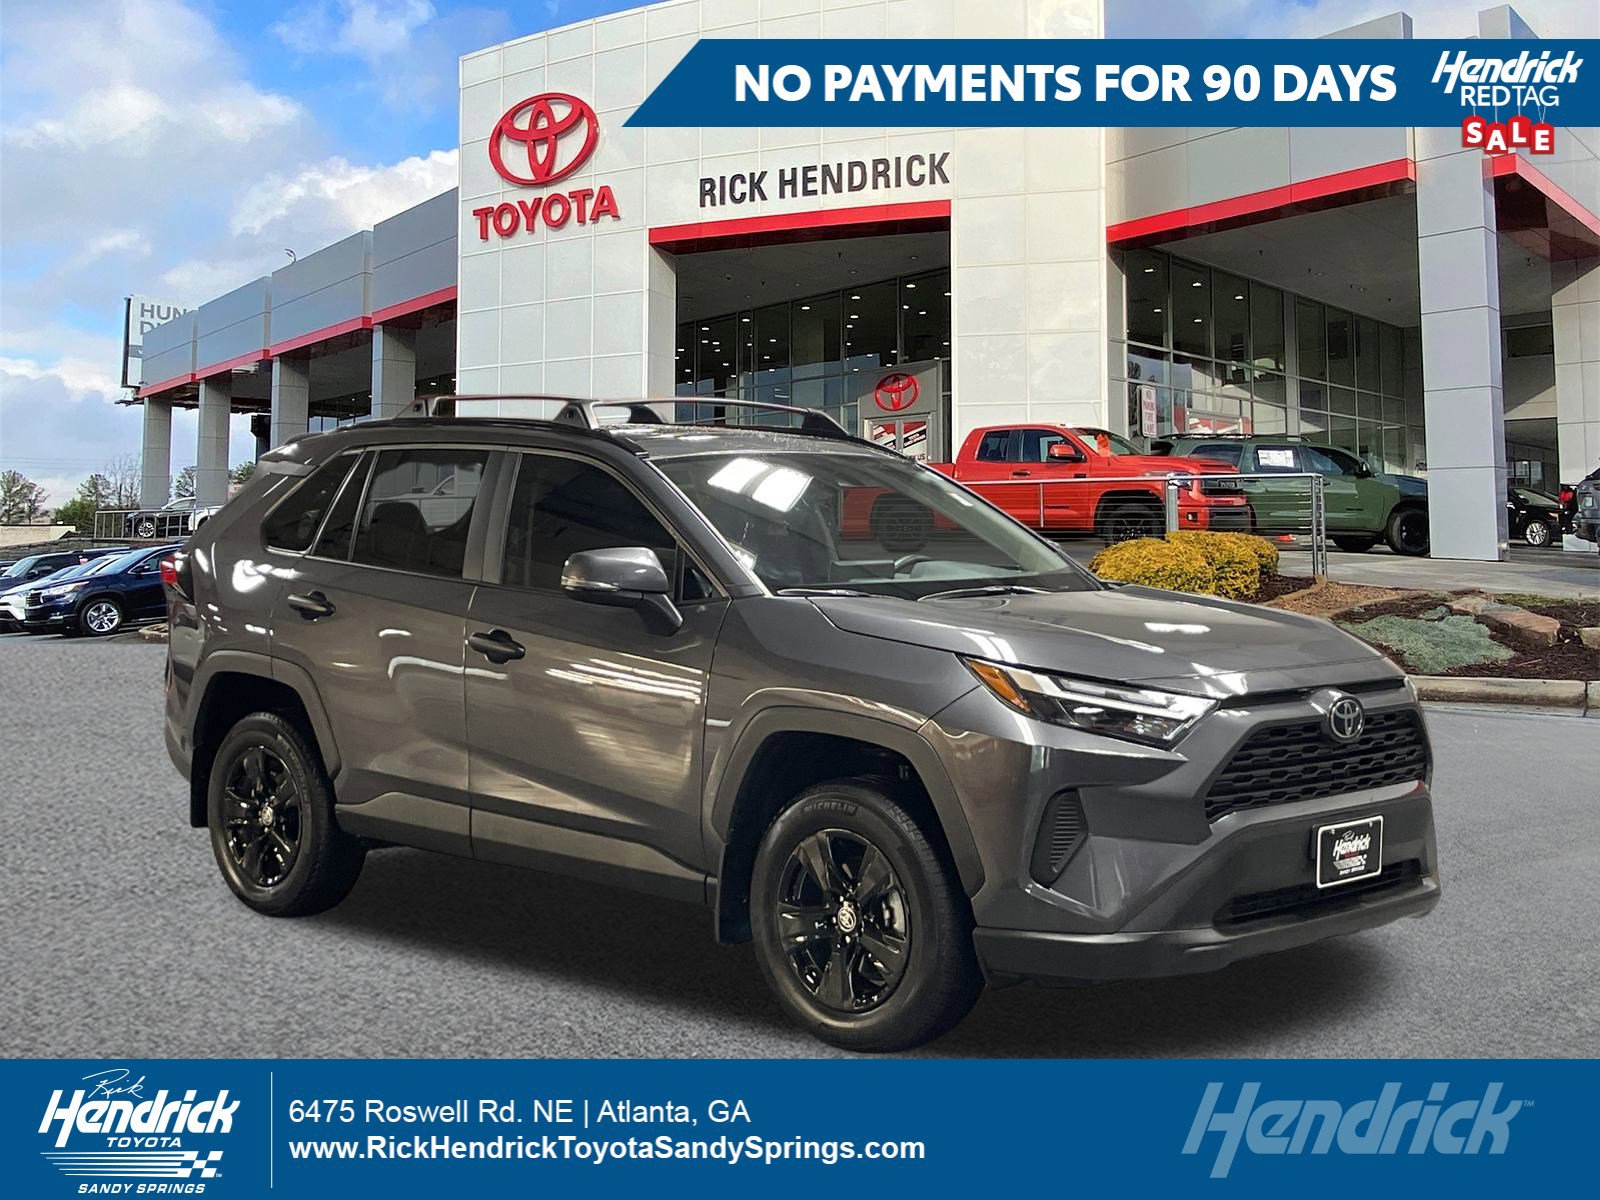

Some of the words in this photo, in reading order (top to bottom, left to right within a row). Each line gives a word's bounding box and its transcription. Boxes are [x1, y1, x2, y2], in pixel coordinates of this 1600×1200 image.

[699, 170, 768, 208] RICK
[779, 152, 950, 199] HENDRICK
[473, 185, 620, 241] TOYOTA
[804, 801, 858, 816] MICHELIN
